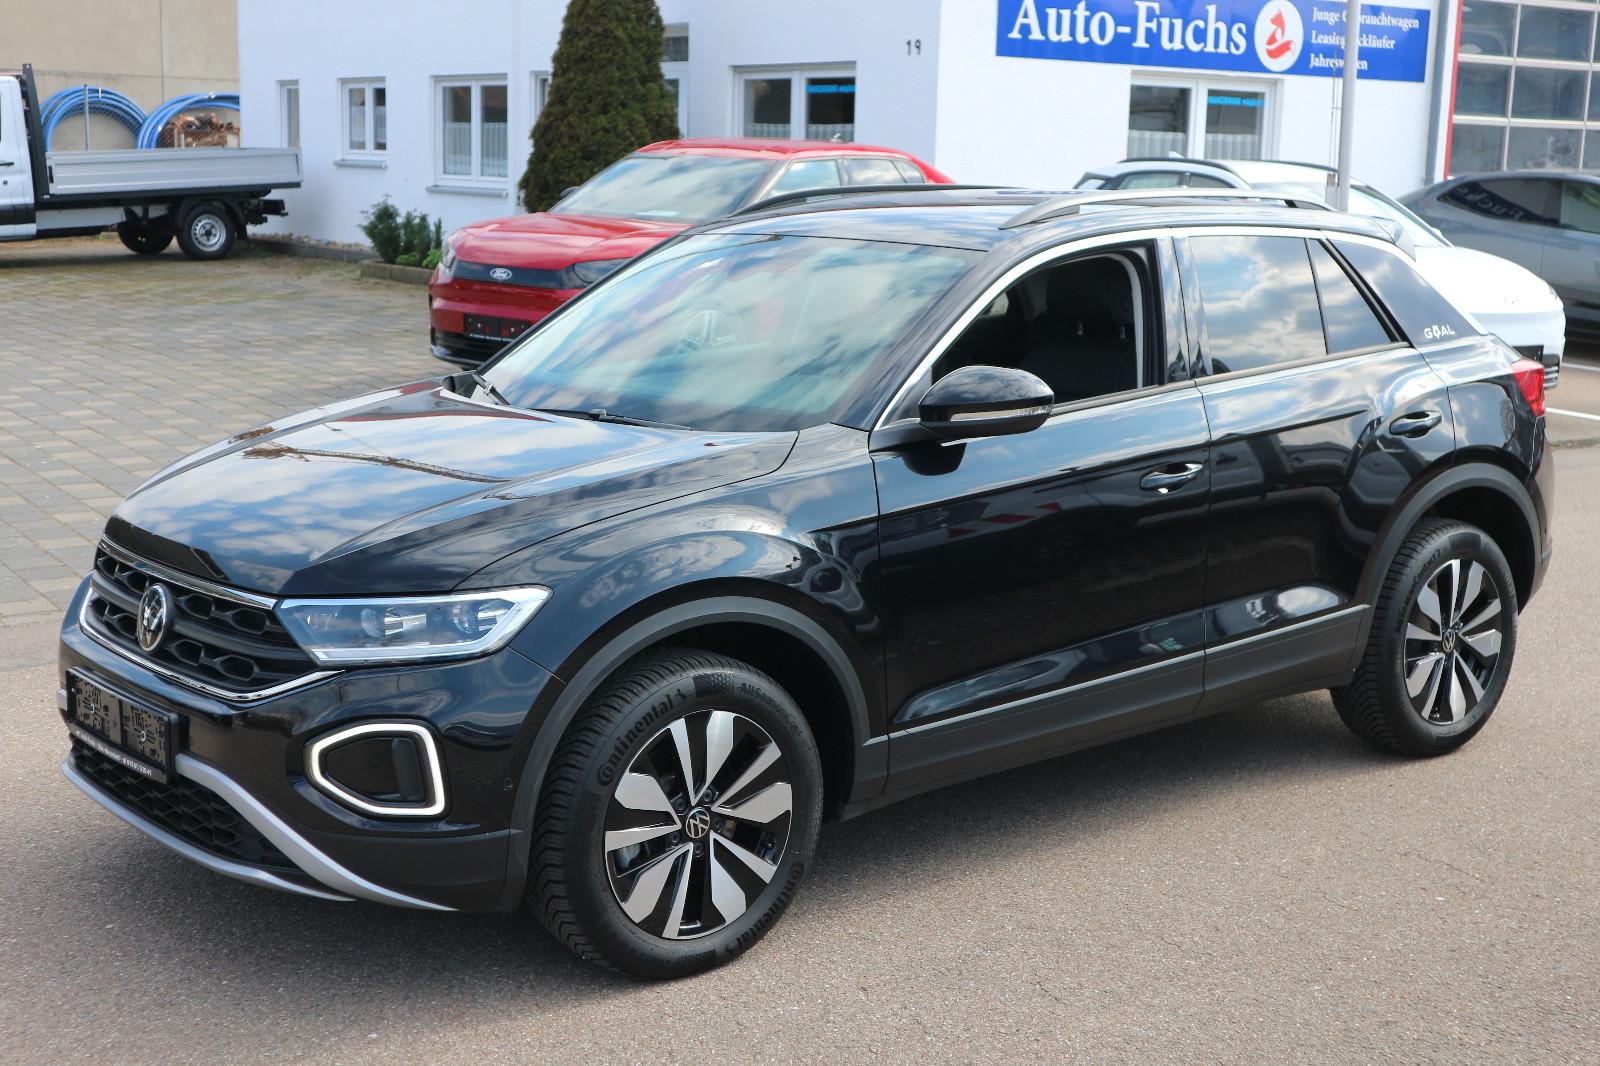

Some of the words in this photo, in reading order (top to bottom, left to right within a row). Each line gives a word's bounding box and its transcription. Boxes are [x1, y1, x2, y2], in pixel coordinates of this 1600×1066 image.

[1008, 0, 1247, 55] Auto-Fuchs
[1312, 7, 1340, 26] Junge
[906, 39, 922, 56] 19
[1423, 324, 1456, 339] GOAL
[598, 693, 674, 786] Continental
[735, 861, 804, 947] Continental
